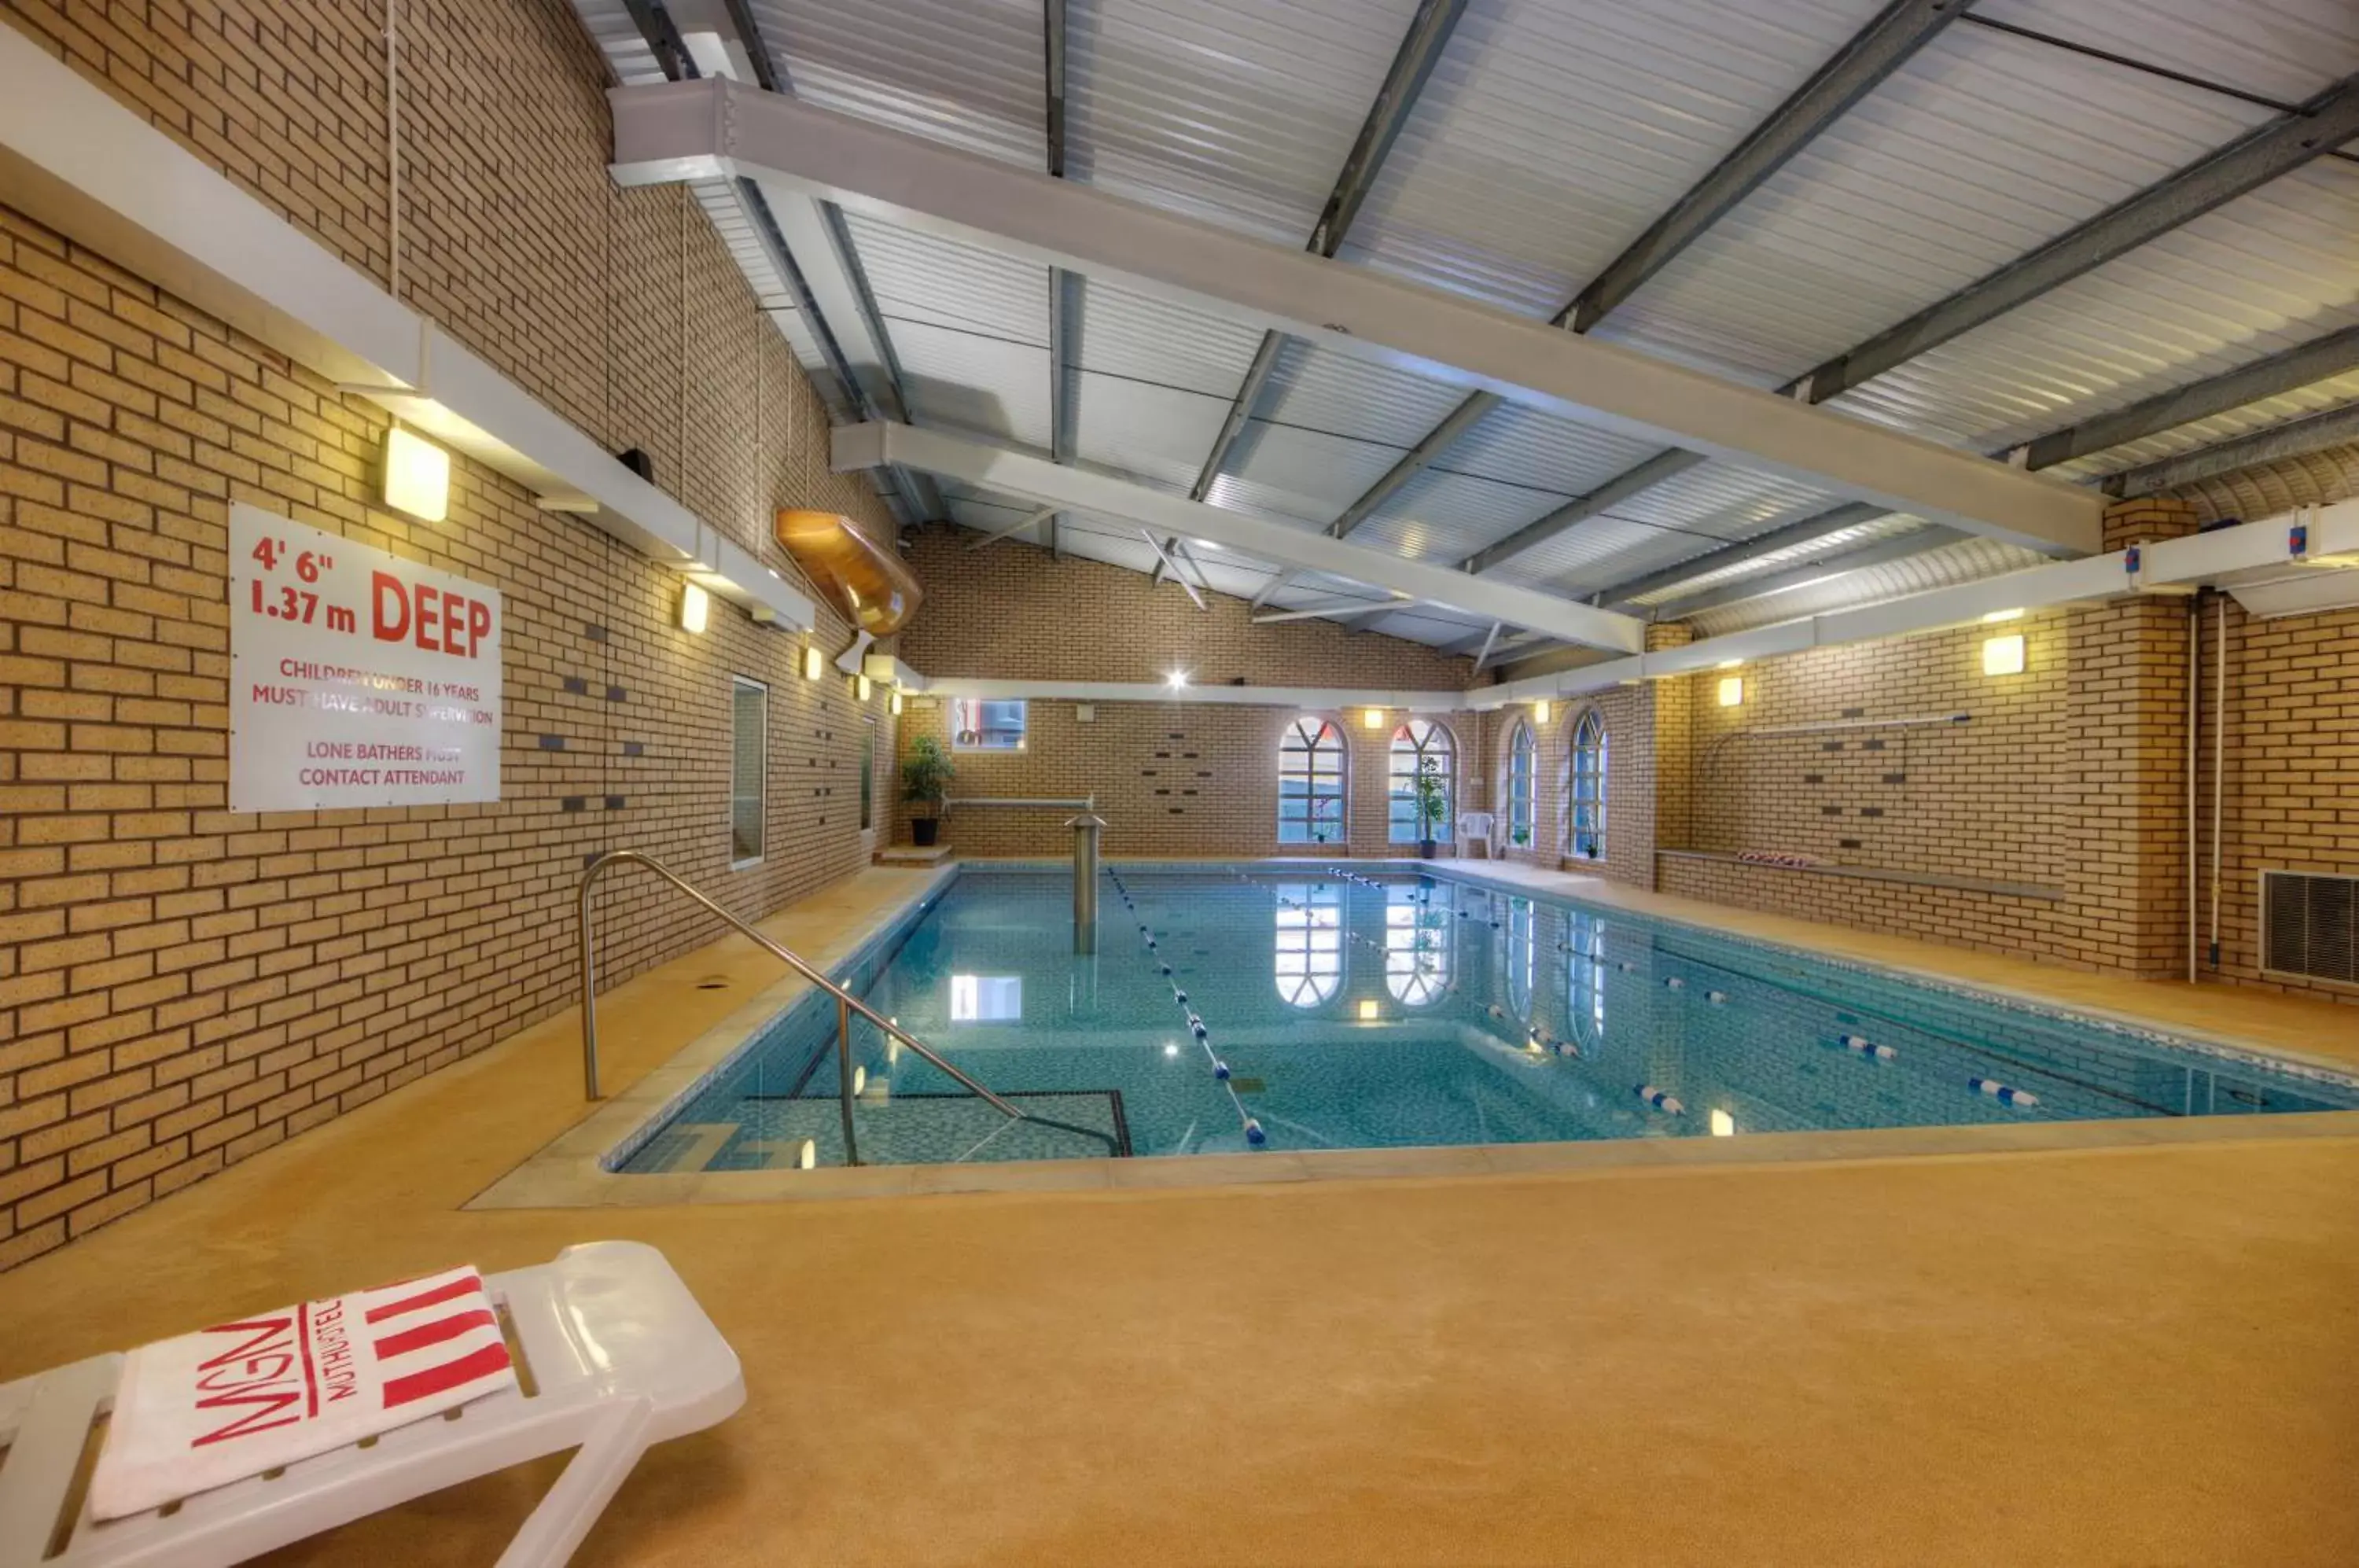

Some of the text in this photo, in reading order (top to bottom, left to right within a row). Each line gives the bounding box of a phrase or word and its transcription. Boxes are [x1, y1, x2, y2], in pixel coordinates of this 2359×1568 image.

[296, 550, 333, 583] 6"
[252, 579, 356, 634] 1.37 m
[372, 569, 491, 659] DEEP
[372, 672, 423, 694] UNDER
[427, 679, 440, 697] 16
[443, 683, 480, 702] YEARS
[252, 683, 308, 708] MUST
[362, 696, 411, 718] ADULT
[414, 702, 494, 725] SERVIION
[307, 742, 353, 759] LONE
[356, 743, 422, 761] BATHERS
[299, 768, 465, 786] CONTACT ATTENDANT
